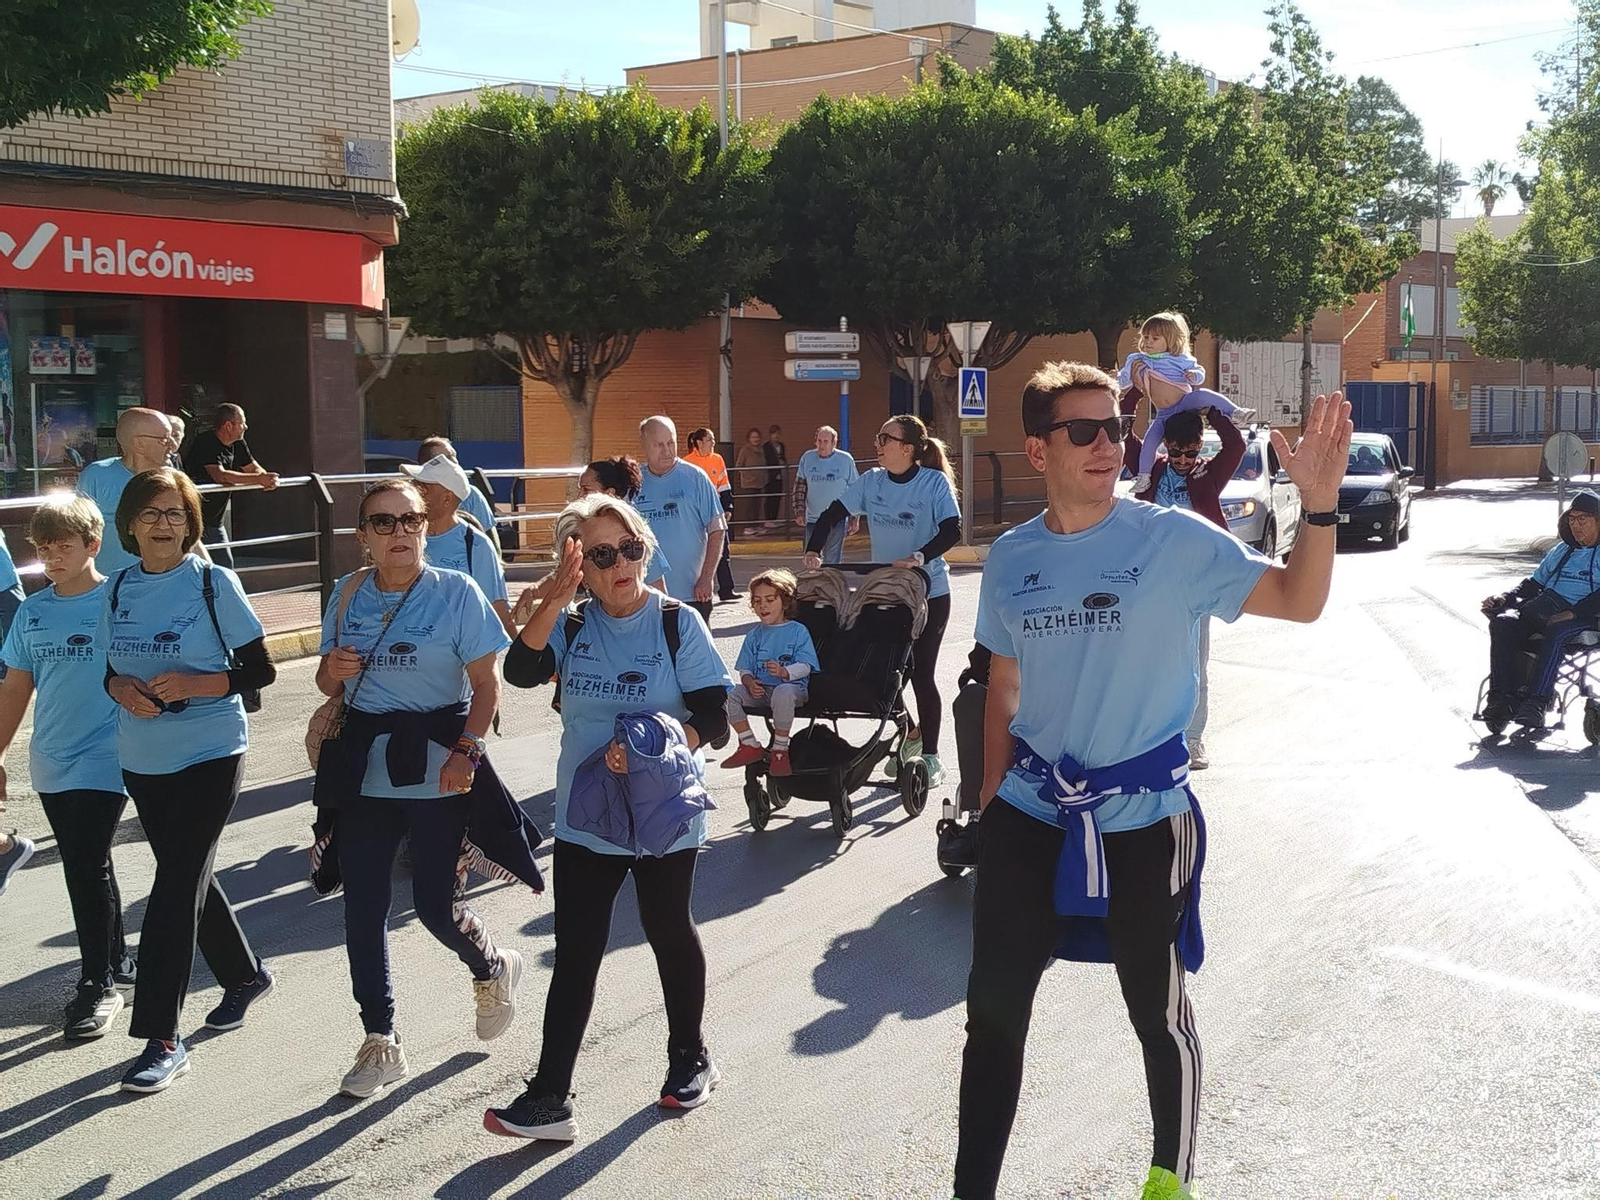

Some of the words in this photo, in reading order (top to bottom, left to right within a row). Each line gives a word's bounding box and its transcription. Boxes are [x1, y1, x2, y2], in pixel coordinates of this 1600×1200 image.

[62, 235, 194, 280] Halcón
[196, 258, 255, 286] viajes
[1022, 605, 1063, 616] ASOCIACIÓN
[1022, 609, 1122, 632] ALZHÉIMER
[109, 640, 181, 654] ALZHÉIMER
[570, 671, 603, 680] ASOCIACIÓN
[565, 677, 647, 697] ALZHÉIMER
